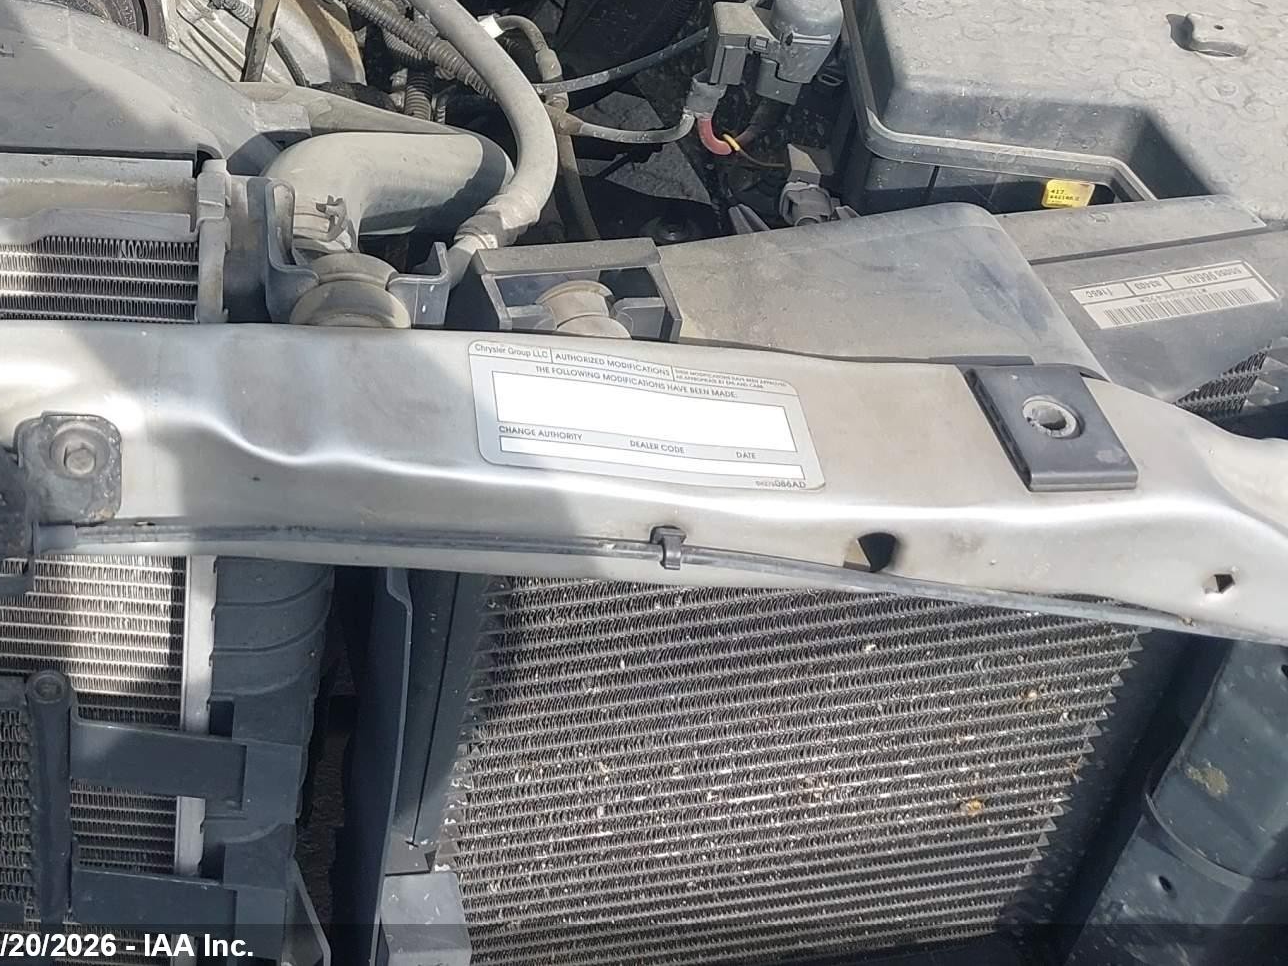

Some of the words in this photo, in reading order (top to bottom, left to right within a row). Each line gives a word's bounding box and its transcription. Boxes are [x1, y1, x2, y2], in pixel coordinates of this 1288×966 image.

[474, 343, 506, 355] Chrysler
[507, 346, 532, 358] Group
[532, 349, 549, 359] LLC
[555, 353, 605, 365] AUTHORIZED
[607, 360, 670, 377] MODIFICATIONS
[536, 366, 551, 374] THE
[552, 368, 601, 379] FOLLOWING
[603, 373, 666, 390] MODIFICATIONS
[667, 384, 689, 394] HAVE
[690, 386, 710, 395] BEEN
[498, 425, 537, 436] CHANGE
[538, 430, 583, 441] AUTHORITY
[629, 439, 659, 450] DEALER
[660, 443, 685, 454] CODE
[735, 451, 757, 460] DATE
